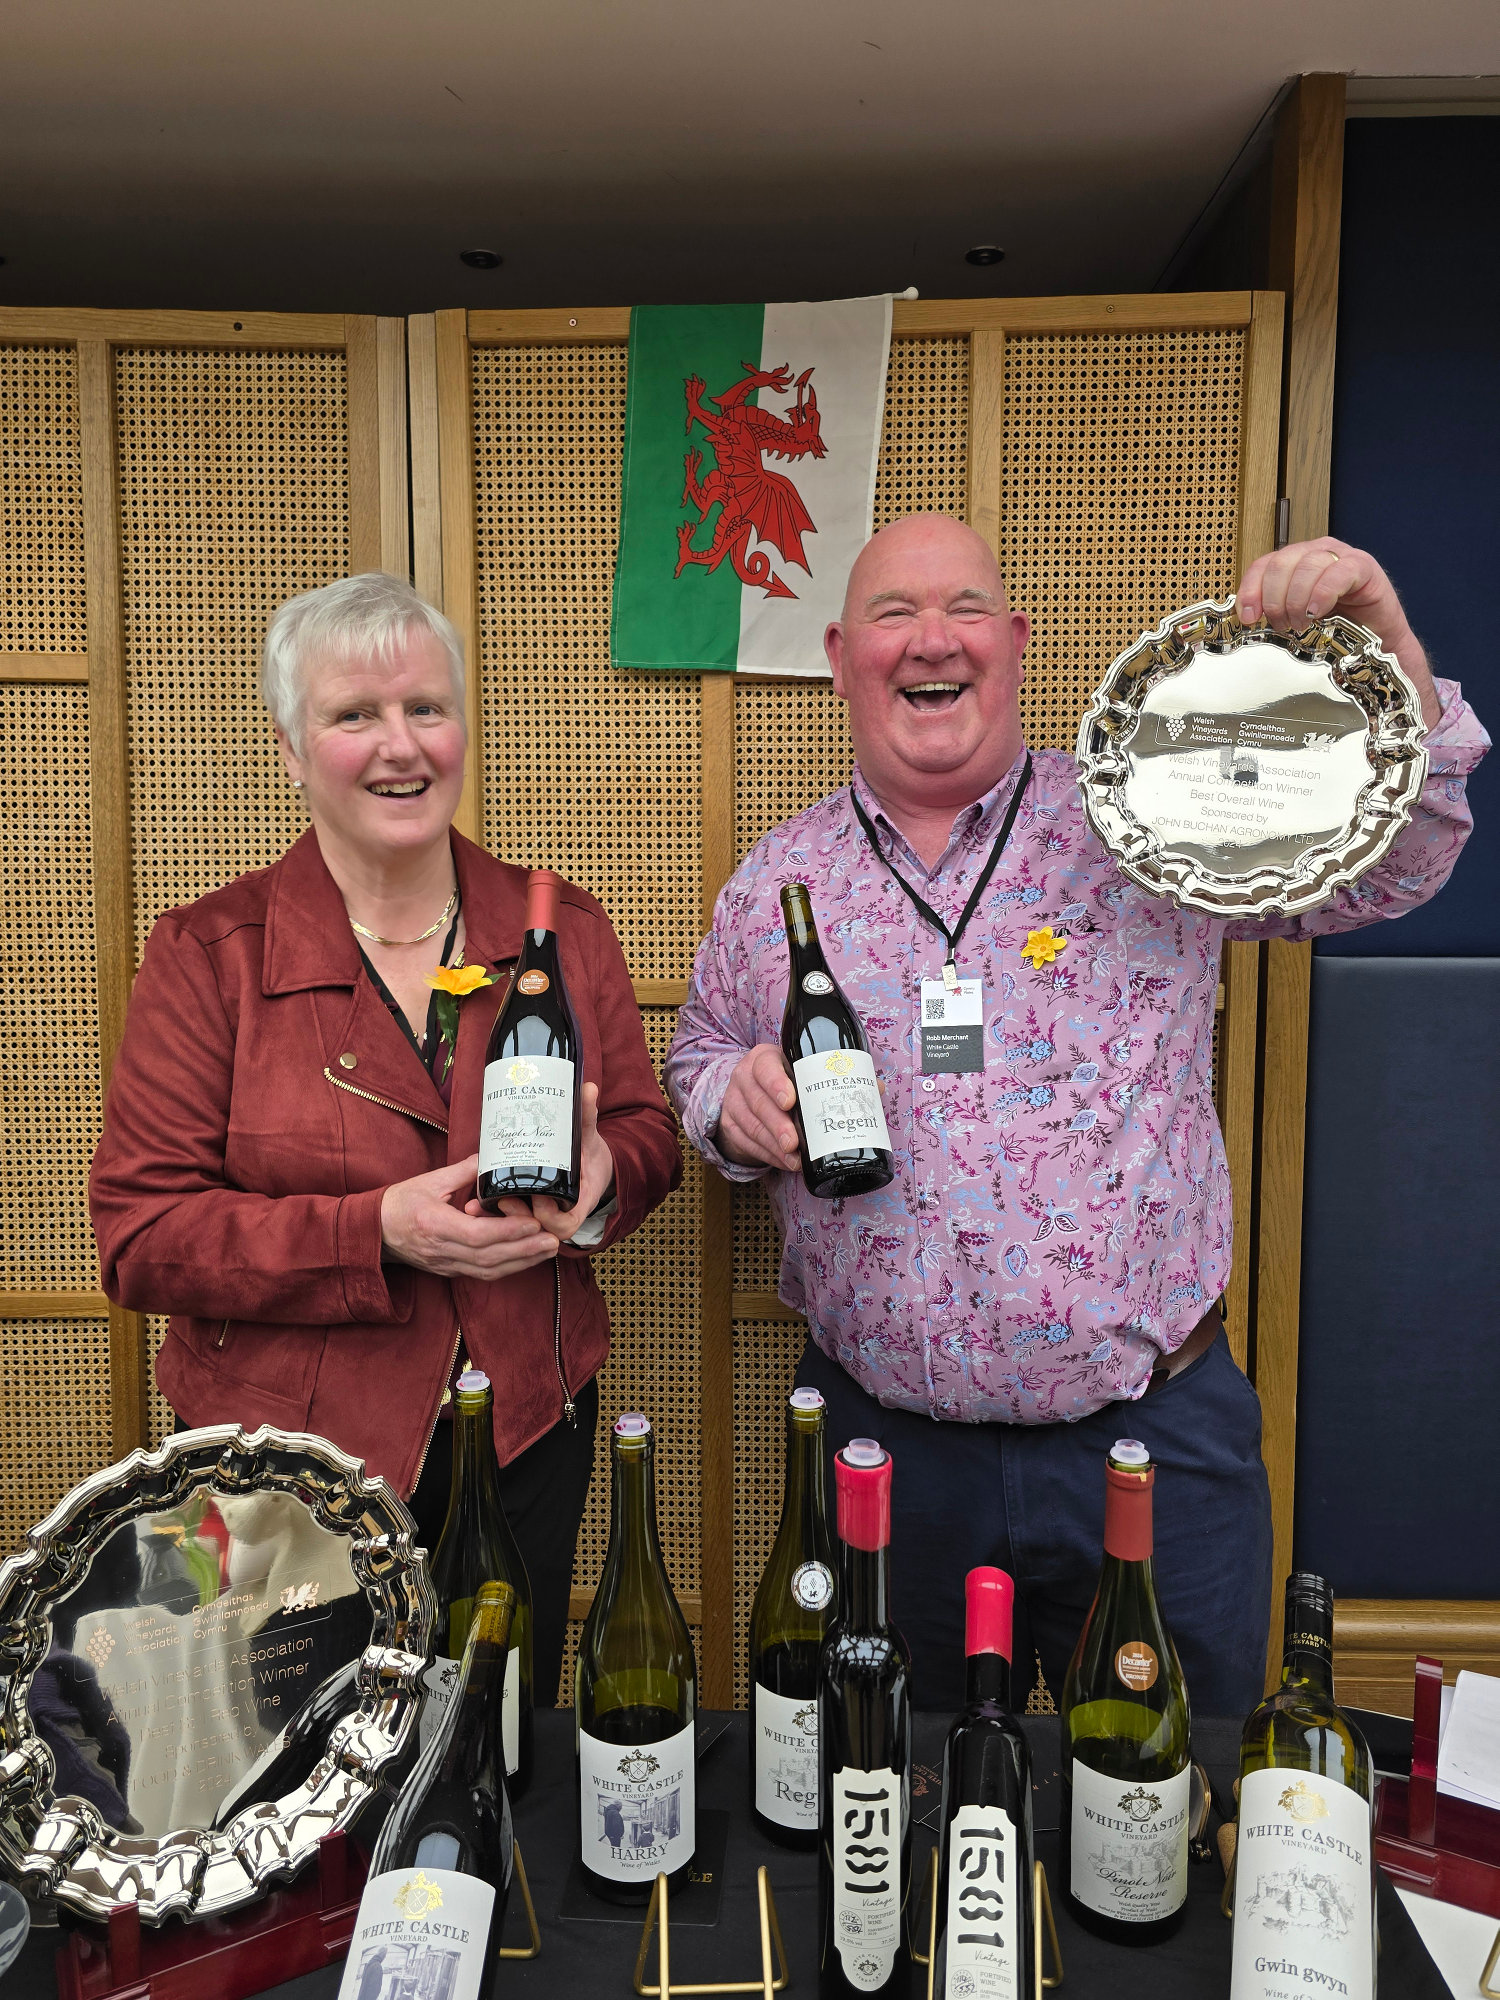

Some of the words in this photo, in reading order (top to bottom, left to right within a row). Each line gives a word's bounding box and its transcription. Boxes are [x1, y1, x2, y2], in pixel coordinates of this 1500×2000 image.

[1193, 716, 1215, 725] Welsh
[1239, 721, 1286, 733] Cymdeithas
[1189, 733, 1233, 744] Association
[1191, 725, 1228, 735] Vineyards
[1238, 730, 1296, 743] Gwinllannoedd
[1236, 738, 1262, 748] Cymru
[1168, 752, 1200, 766] Welsh
[1202, 757, 1255, 773] Vineyards
[1259, 763, 1321, 780] Association
[1167, 769, 1205, 784] Annual
[1207, 774, 1274, 792] Competition
[1276, 783, 1314, 797] Winner
[1190, 788, 1214, 801] Best
[1217, 792, 1256, 806] Overall
[1258, 798, 1285, 810] Wine
[1200, 806, 1254, 822] Sponsored
[1256, 813, 1269, 825] by
[1151, 816, 1182, 829] JOHN
[1183, 820, 1228, 834] BUCHAN
[1294, 834, 1315, 845] LTD
[487, 1087, 517, 1102] WHITE
[521, 1086, 566, 1098] CASTLE
[805, 1078, 839, 1094] WHITE
[842, 1076, 876, 1088] CASTLE
[490, 1127, 524, 1140] Pinot
[522, 1125, 556, 1138] Noir
[821, 1116, 879, 1134] Regent
[499, 1139, 545, 1150] Reserve
[192, 1592, 254, 1616] Cymdeithas
[124, 1616, 157, 1632] Welsh
[125, 1623, 178, 1643] Vineyards
[193, 1624, 229, 1640] Cymru
[125, 1634, 187, 1657] Association
[229, 1636, 314, 1669] Association
[1122, 1655, 1152, 1666] Decanter
[259, 1661, 310, 1685] Winner
[245, 1694, 281, 1714] Wine
[428, 1687, 450, 1703] HITE
[763, 1725, 805, 1748] WHITE
[592, 1775, 632, 1793] WHITE
[637, 1769, 684, 1793] CASTLE
[774, 1779, 818, 1809] Reg
[1083, 1806, 1133, 1834] WHITE
[1139, 1809, 1186, 1834] CASTLE
[844, 1787, 890, 1894] 1581
[1120, 1832, 1158, 1840] VINEYARD
[1246, 1824, 1294, 1840] WHITE
[1301, 1828, 1363, 1866] CASTLE
[611, 1842, 669, 1861] HARRY
[1281, 1839, 1328, 1856] VINEYARD
[636, 1861, 644, 1869] of
[644, 1859, 661, 1867] Wales
[1096, 1867, 1144, 1886] Pinot
[1142, 1866, 1177, 1888] Noir
[957, 1826, 1005, 1949] 1581
[1109, 1886, 1168, 1900] Reserve
[862, 1897, 895, 1907] Vintage
[867, 1910, 896, 1920] FORTIFIED
[361, 1920, 405, 1940] WHITE
[410, 1921, 470, 1944] CASTLE
[390, 1934, 428, 1942] VINEYARD
[975, 1949, 1010, 1967] Vintage
[980, 1971, 1012, 1985] FORTIFIED
[980, 1979, 997, 1987] WINE
[1255, 1957, 1300, 1976] Gwin
[1303, 1967, 1349, 1996] gwyn
[1264, 1988, 1289, 1998] Wine
